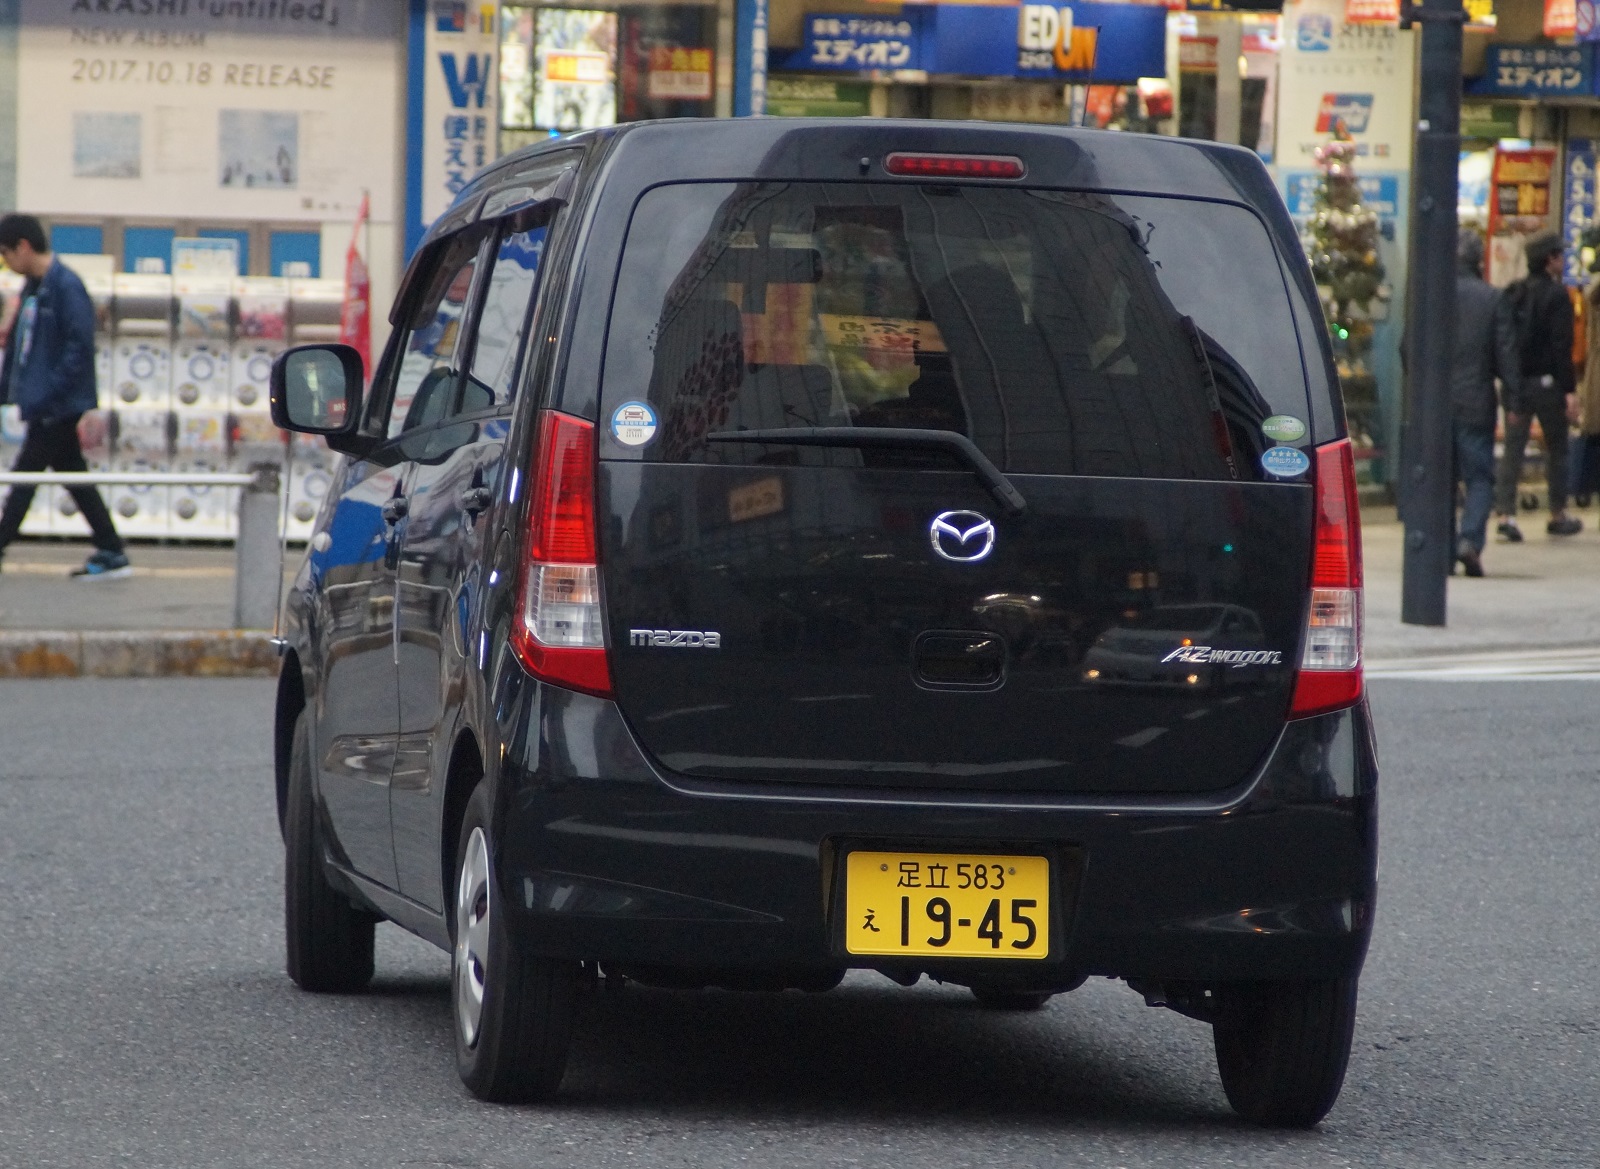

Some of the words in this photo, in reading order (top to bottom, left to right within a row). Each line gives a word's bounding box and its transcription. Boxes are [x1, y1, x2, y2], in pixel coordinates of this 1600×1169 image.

[70, 27, 125, 45] NEW
[130, 29, 207, 47] ALBUM
[811, 39, 911, 66] エディオン
[71, 58, 213, 85] 2017.10.18
[224, 63, 336, 89] RELEASE
[1496, 65, 1582, 88] エディオン
[629, 628, 721, 649] mazda
[862, 908, 881, 933] え
[901, 896, 1037, 950] 19-45
